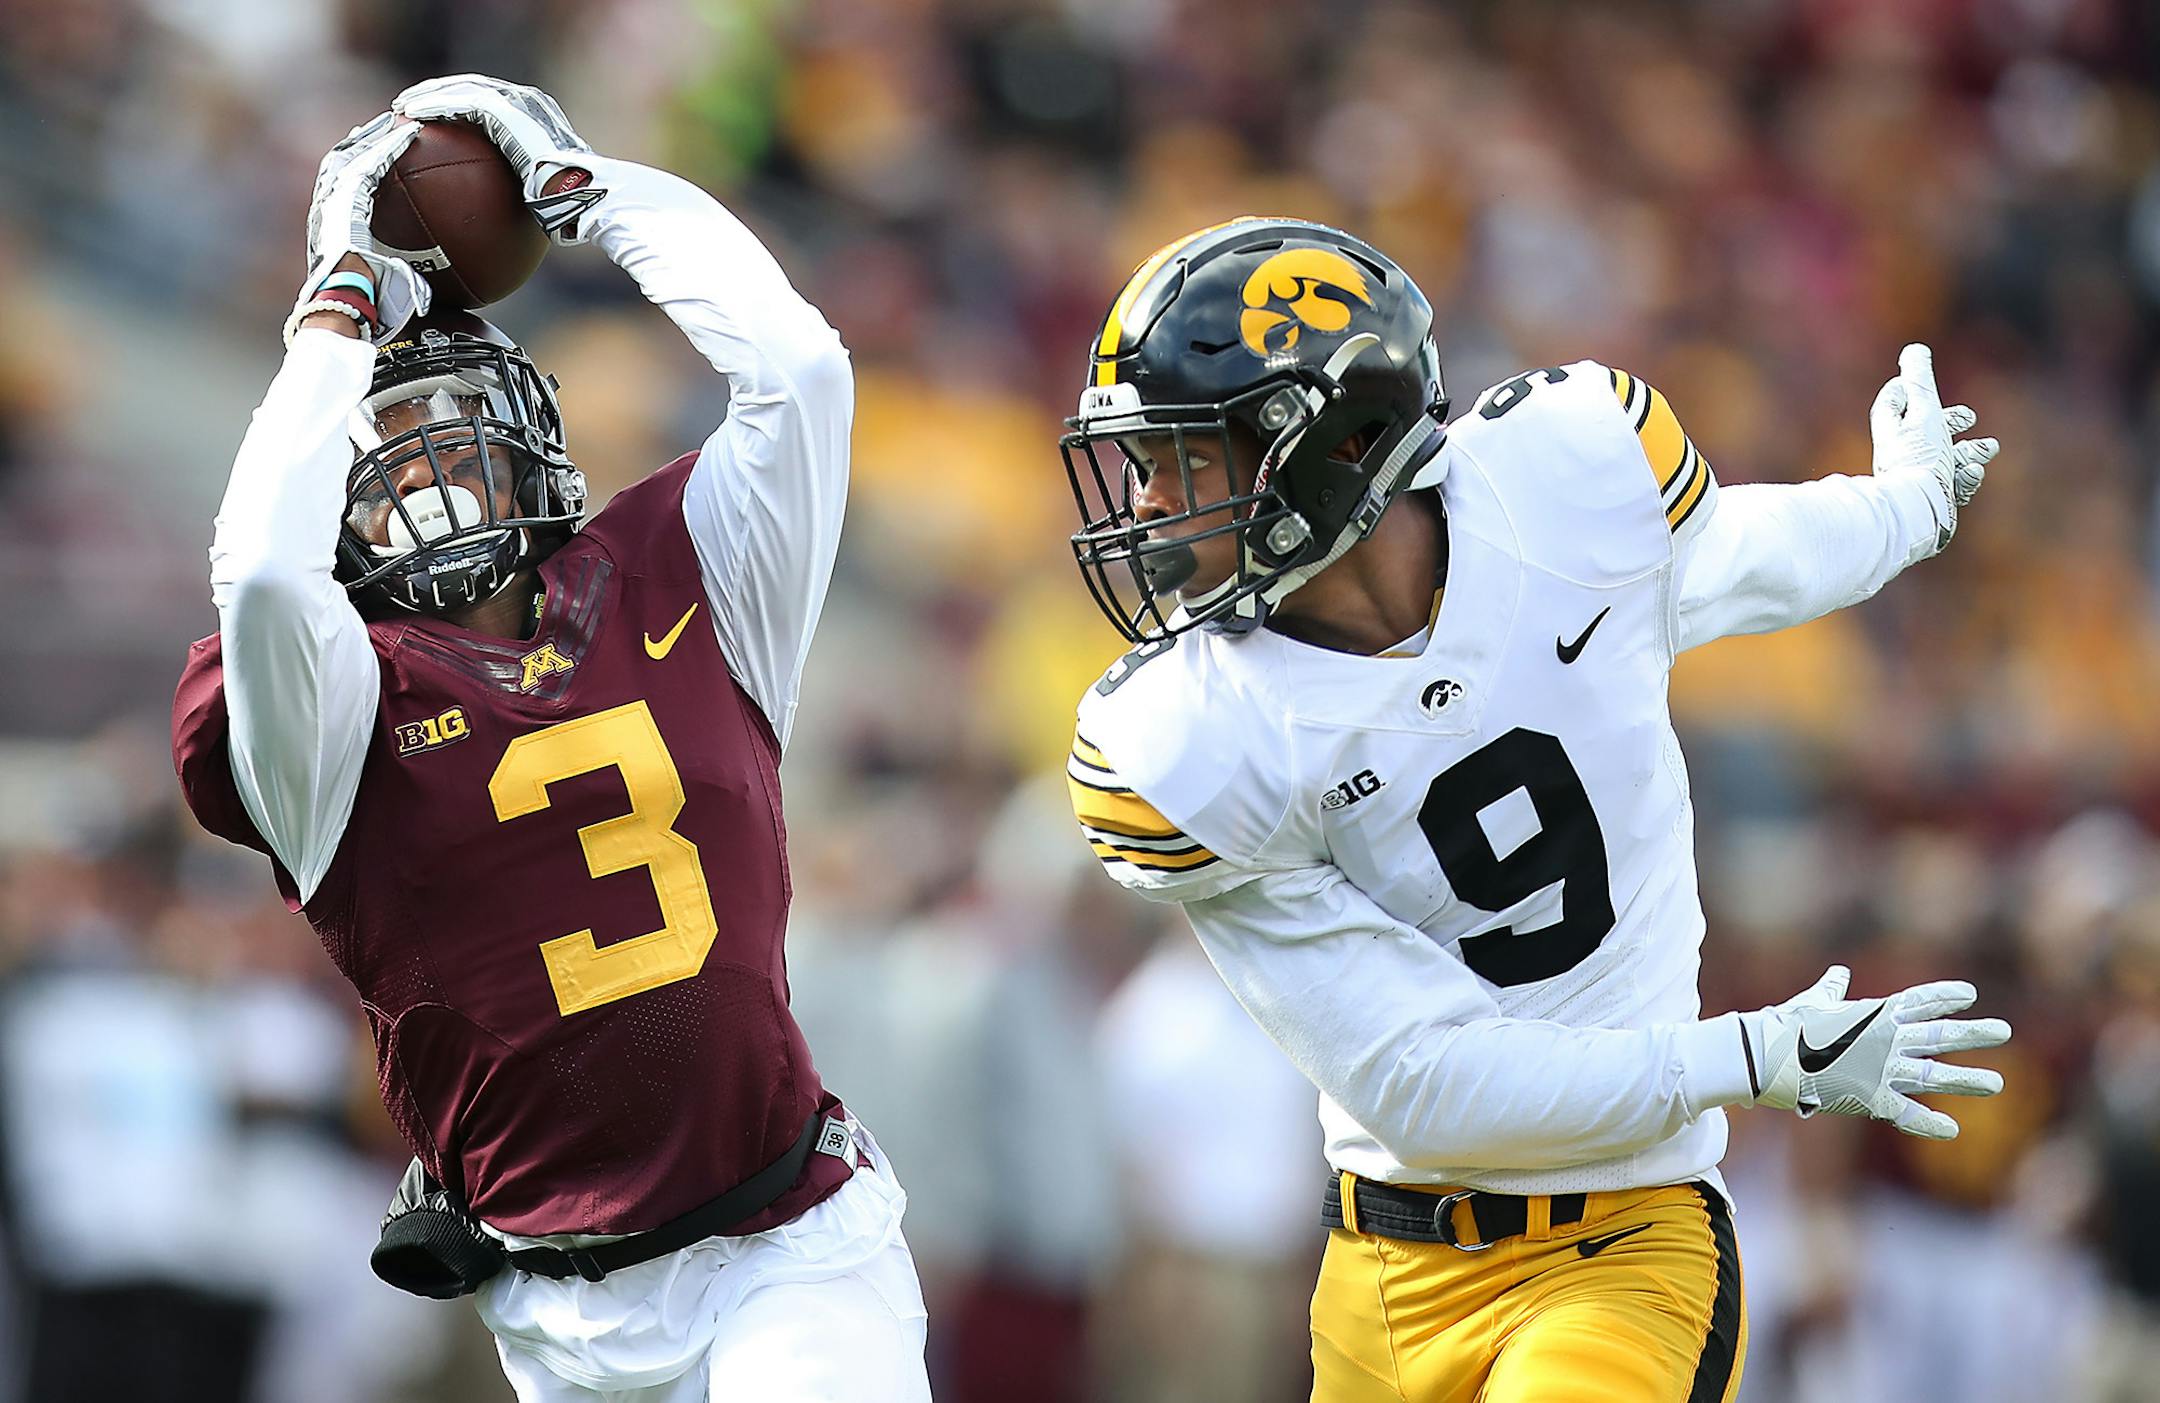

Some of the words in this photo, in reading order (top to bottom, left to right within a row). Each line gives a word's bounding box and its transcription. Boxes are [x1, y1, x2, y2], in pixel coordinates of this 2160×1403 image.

[520, 643, 575, 692] M
[488, 699, 719, 1017] 3
[1417, 726, 1618, 989] 9
[827, 1132, 845, 1149] 38
